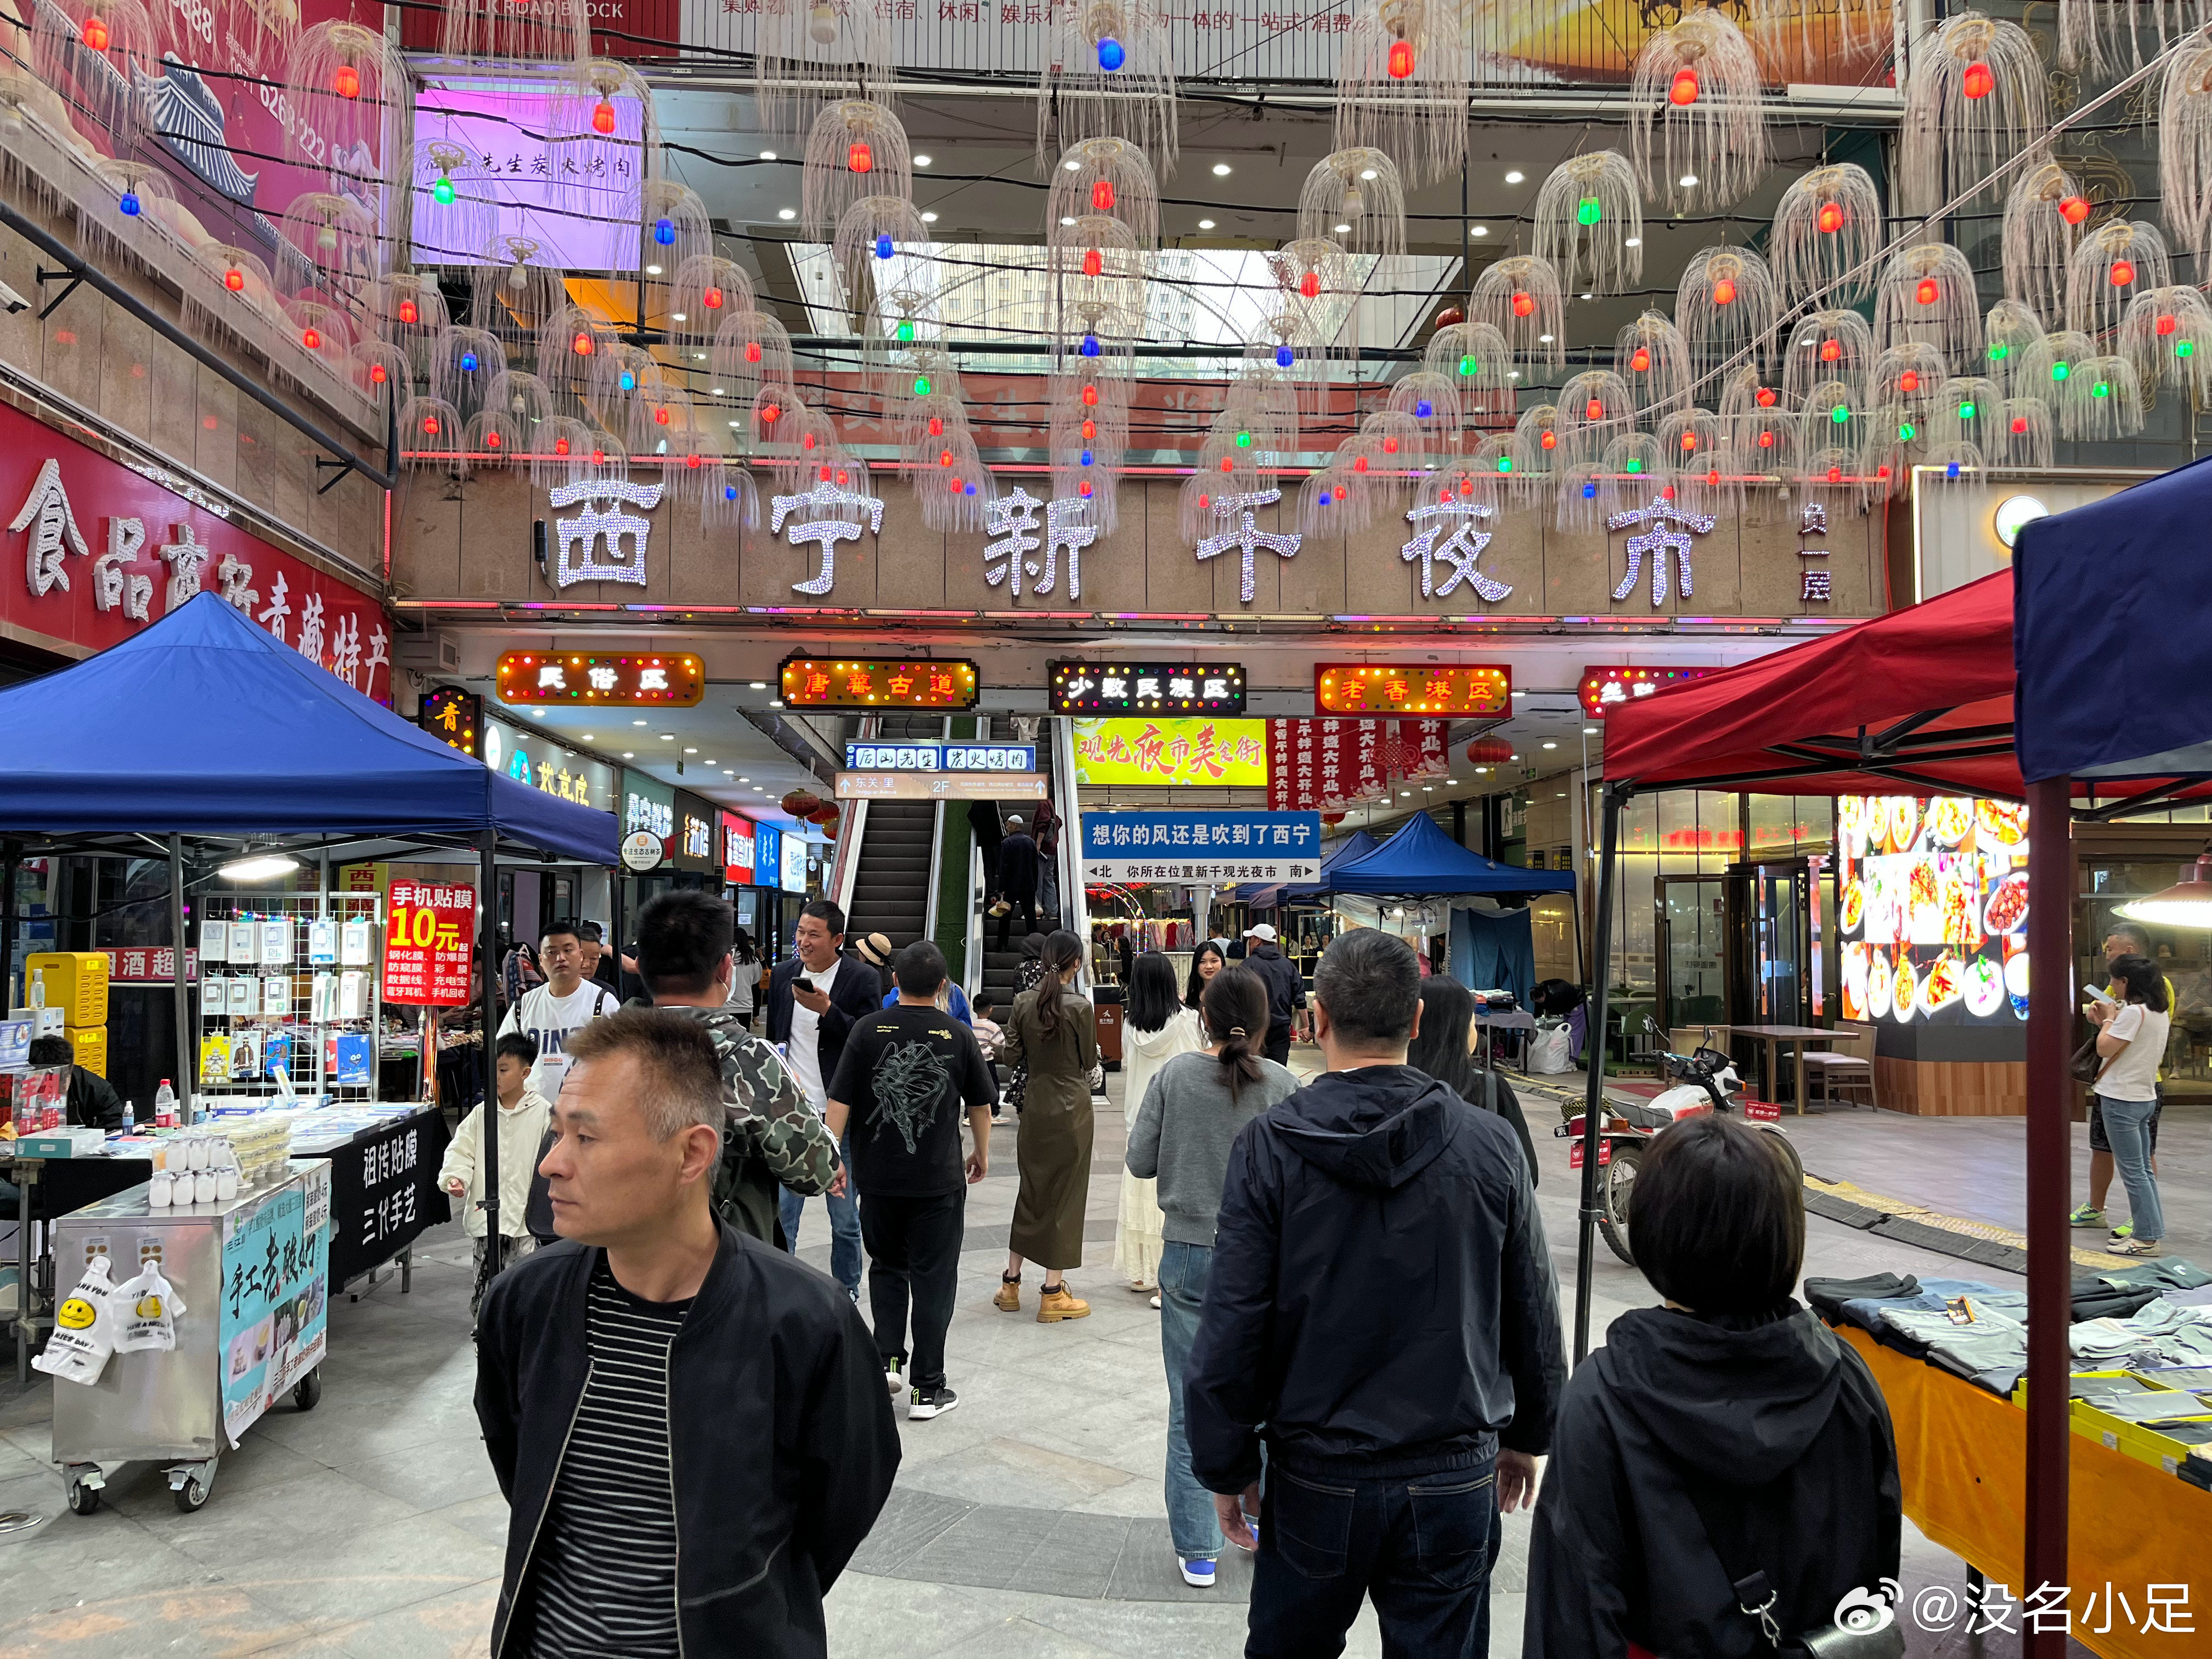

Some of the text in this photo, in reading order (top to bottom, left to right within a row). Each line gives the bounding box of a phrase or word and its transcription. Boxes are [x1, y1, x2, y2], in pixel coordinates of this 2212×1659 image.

[561, 2, 623, 18] BOCK
[549, 479, 1717, 607] 西宁新千夜市
[1798, 502, 1832, 602] 负一层
[538, 667, 669, 690] 民俗区
[1068, 676, 1229, 699] 少数民族区
[1341, 679, 1494, 702] 老香港区
[858, 748, 1025, 768] 后山先生 炭火烤肉
[1077, 723, 1263, 778] 观光夜市美食街
[933, 781, 950, 793] 2F
[1092, 823, 1310, 846] 想你的风还是吹到了西宁
[1099, 865, 1303, 878] 北 你所在位置新千观光夜市 南
[392, 887, 472, 909] 手机贴膜
[436, 952, 469, 962] 防爆膜
[433, 976, 467, 986] 充电宝
[431, 988, 466, 998] 手机回收
[364, 1128, 417, 1189] 祖传贴膜
[363, 1182, 416, 1245] 三代手艺
[230, 1226, 316, 1319] 手工老酸奶
[91, 1285, 109, 1297] YOU
